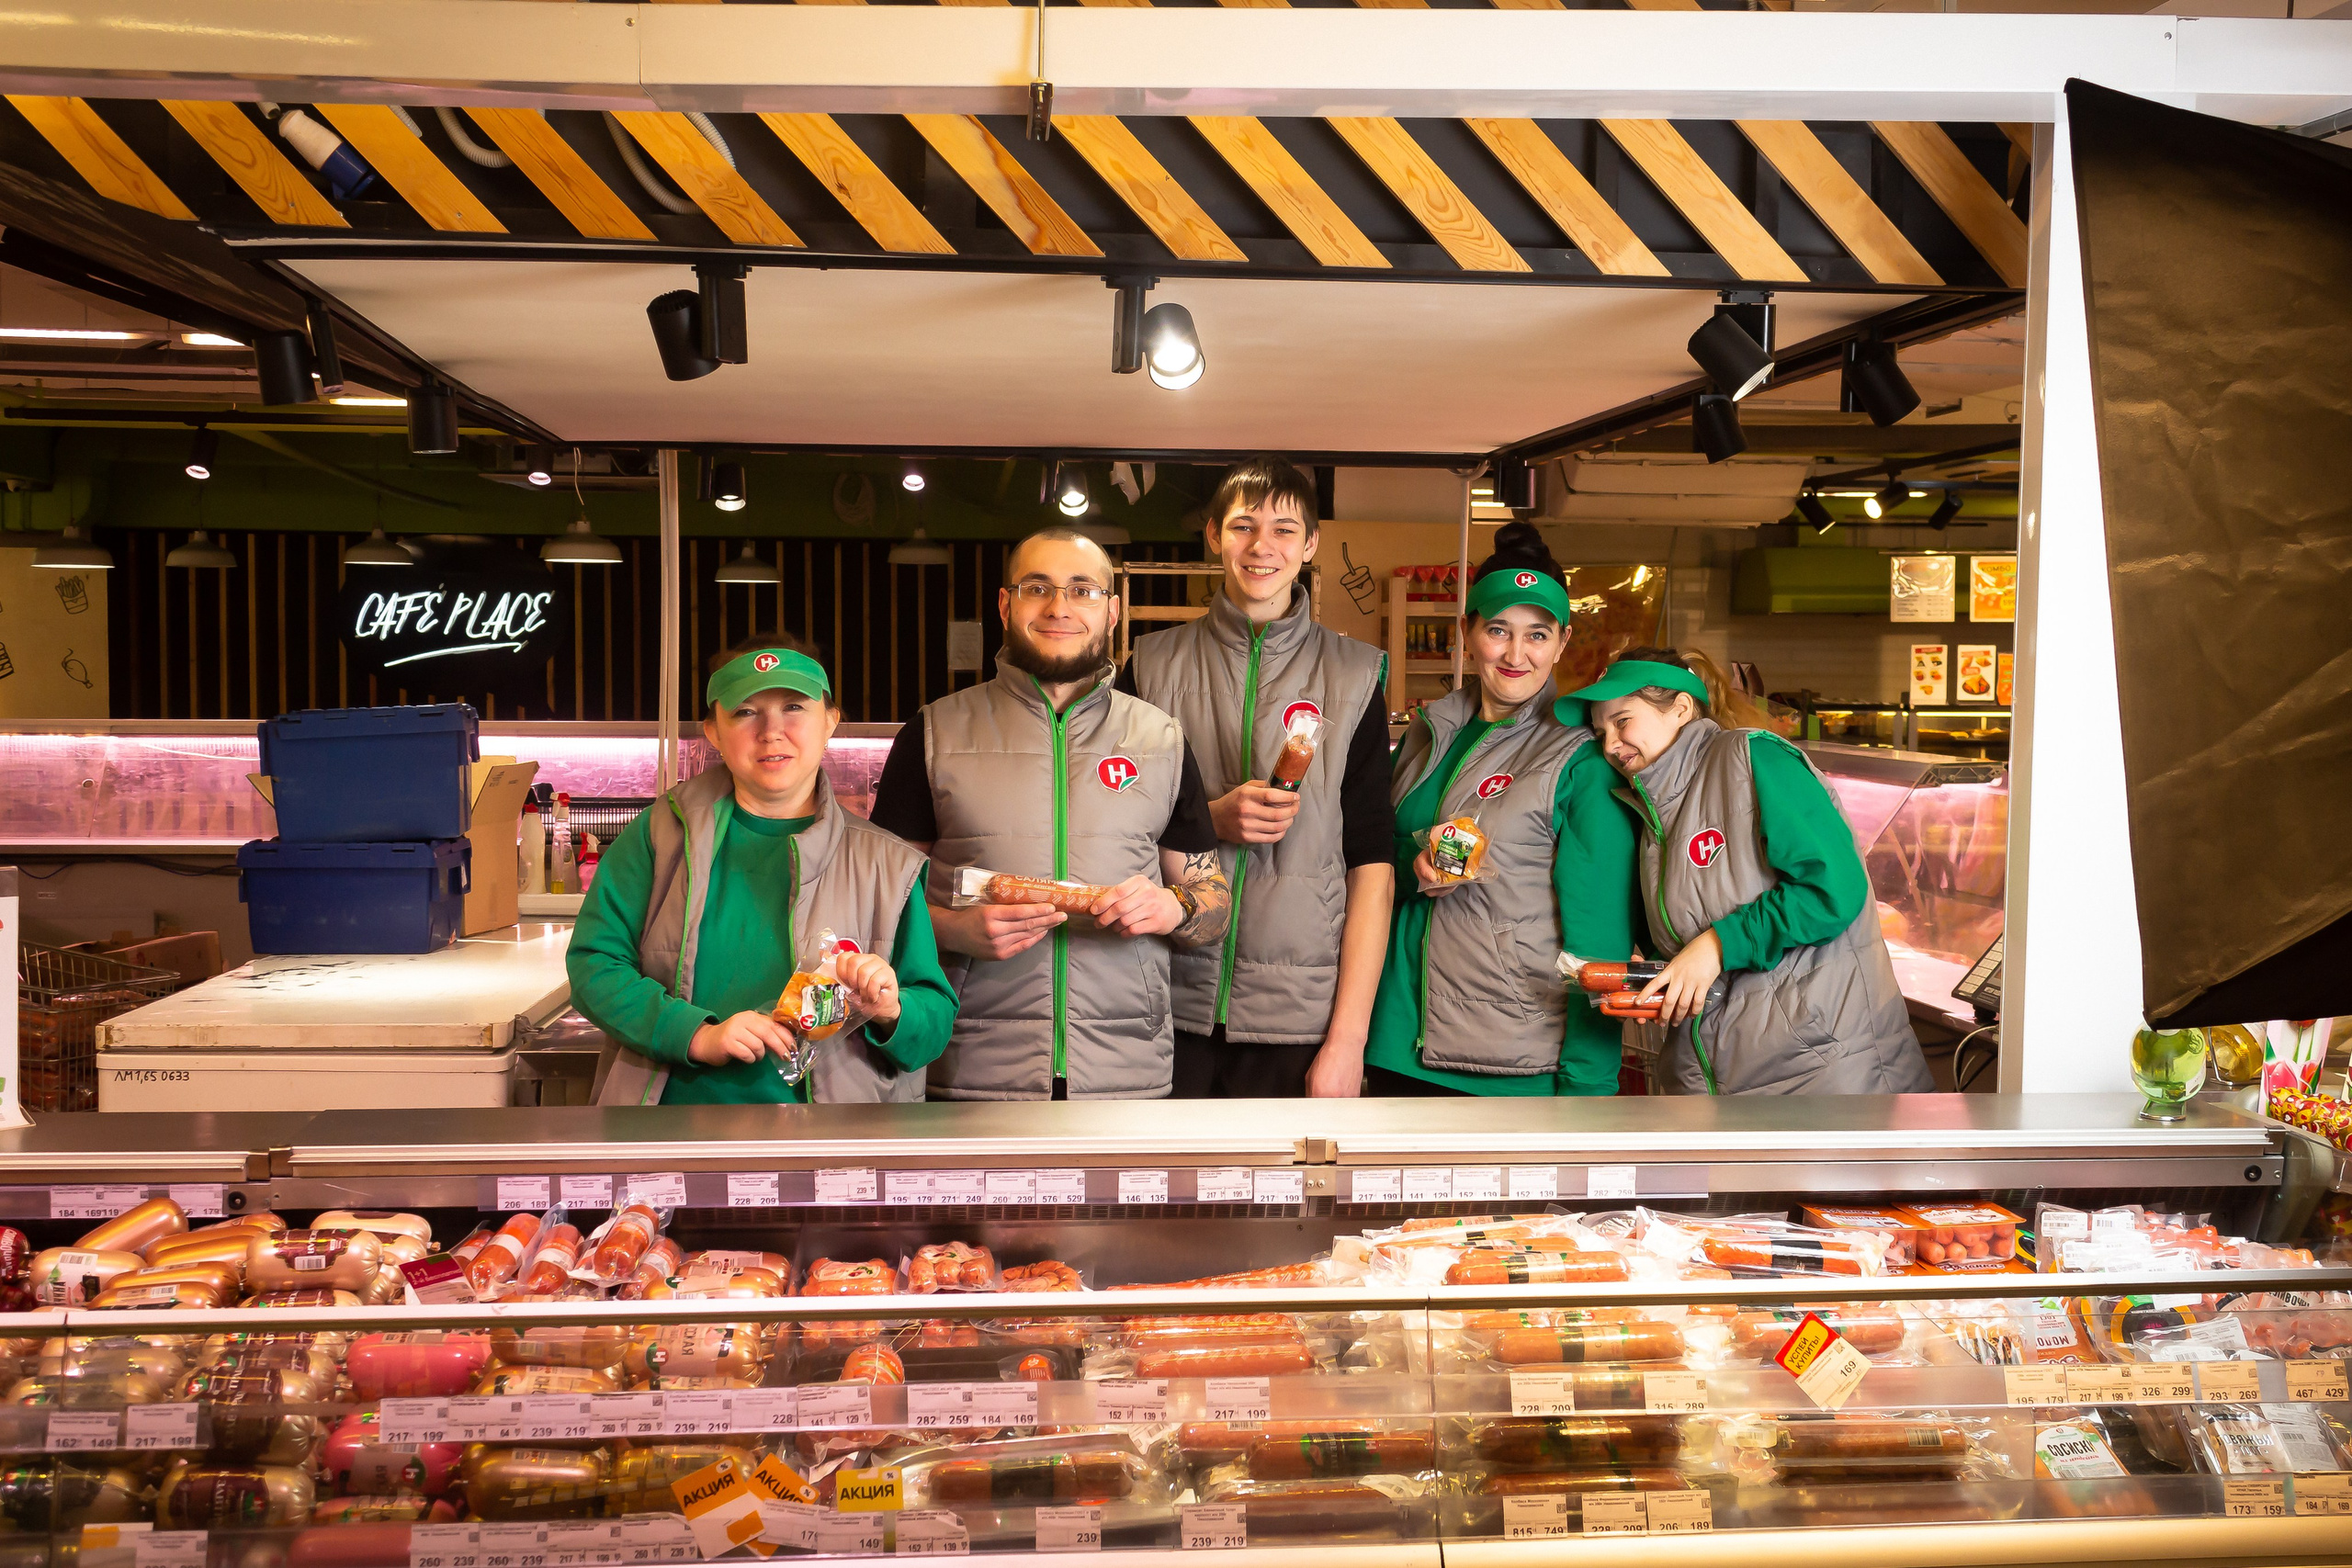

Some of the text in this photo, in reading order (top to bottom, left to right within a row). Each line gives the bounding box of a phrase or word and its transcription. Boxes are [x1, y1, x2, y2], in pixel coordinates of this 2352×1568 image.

[443, 590, 555, 640] PLACE
[162, 1071, 190, 1081] 0633
[2036, 1335, 2069, 1348] МОЛО
[1788, 1337, 1809, 1364] УСПЕЙ
[1796, 1336, 1820, 1370] КУПИТЬ!
[1839, 1360, 1857, 1377] 169
[2143, 1386, 2190, 1396] 326 299
[2210, 1391, 2257, 1401] 293 269
[2296, 1388, 2344, 1398] 467 429
[2080, 1393, 2123, 1402] 217 199
[1521, 1404, 1571, 1414] 228 209
[1685, 1403, 1704, 1411] 289
[773, 1414, 793, 1424] 228
[846, 1415, 859, 1424] 129
[981, 1414, 1034, 1425] 184 169
[1108, 1410, 1156, 1421] 152 139
[1215, 1409, 1266, 1420] 217 199
[916, 1415, 968, 1426] 282 259
[531, 1427, 586, 1437] 239 219
[674, 1423, 729, 1433] 239 219
[388, 1431, 443, 1442] 217 199
[55, 1438, 113, 1448] 162 149
[136, 1437, 192, 1447] 217 199
[684, 1472, 735, 1508] АКЦИЯ
[840, 1483, 895, 1500] АКЦИЯ
[2305, 1501, 2318, 1509] 184
[2233, 1506, 2281, 1515] 173 159
[1659, 1522, 1710, 1531] 206 189
[1512, 1527, 1564, 1537] 815 749
[1077, 1532, 1097, 1543] 239
[1192, 1536, 1244, 1547] 239 219
[859, 1539, 879, 1549] 149
[943, 1541, 956, 1551] 139
[419, 1556, 475, 1567] 260 239
[487, 1555, 543, 1566] 260 239
[560, 1554, 573, 1563] 217
